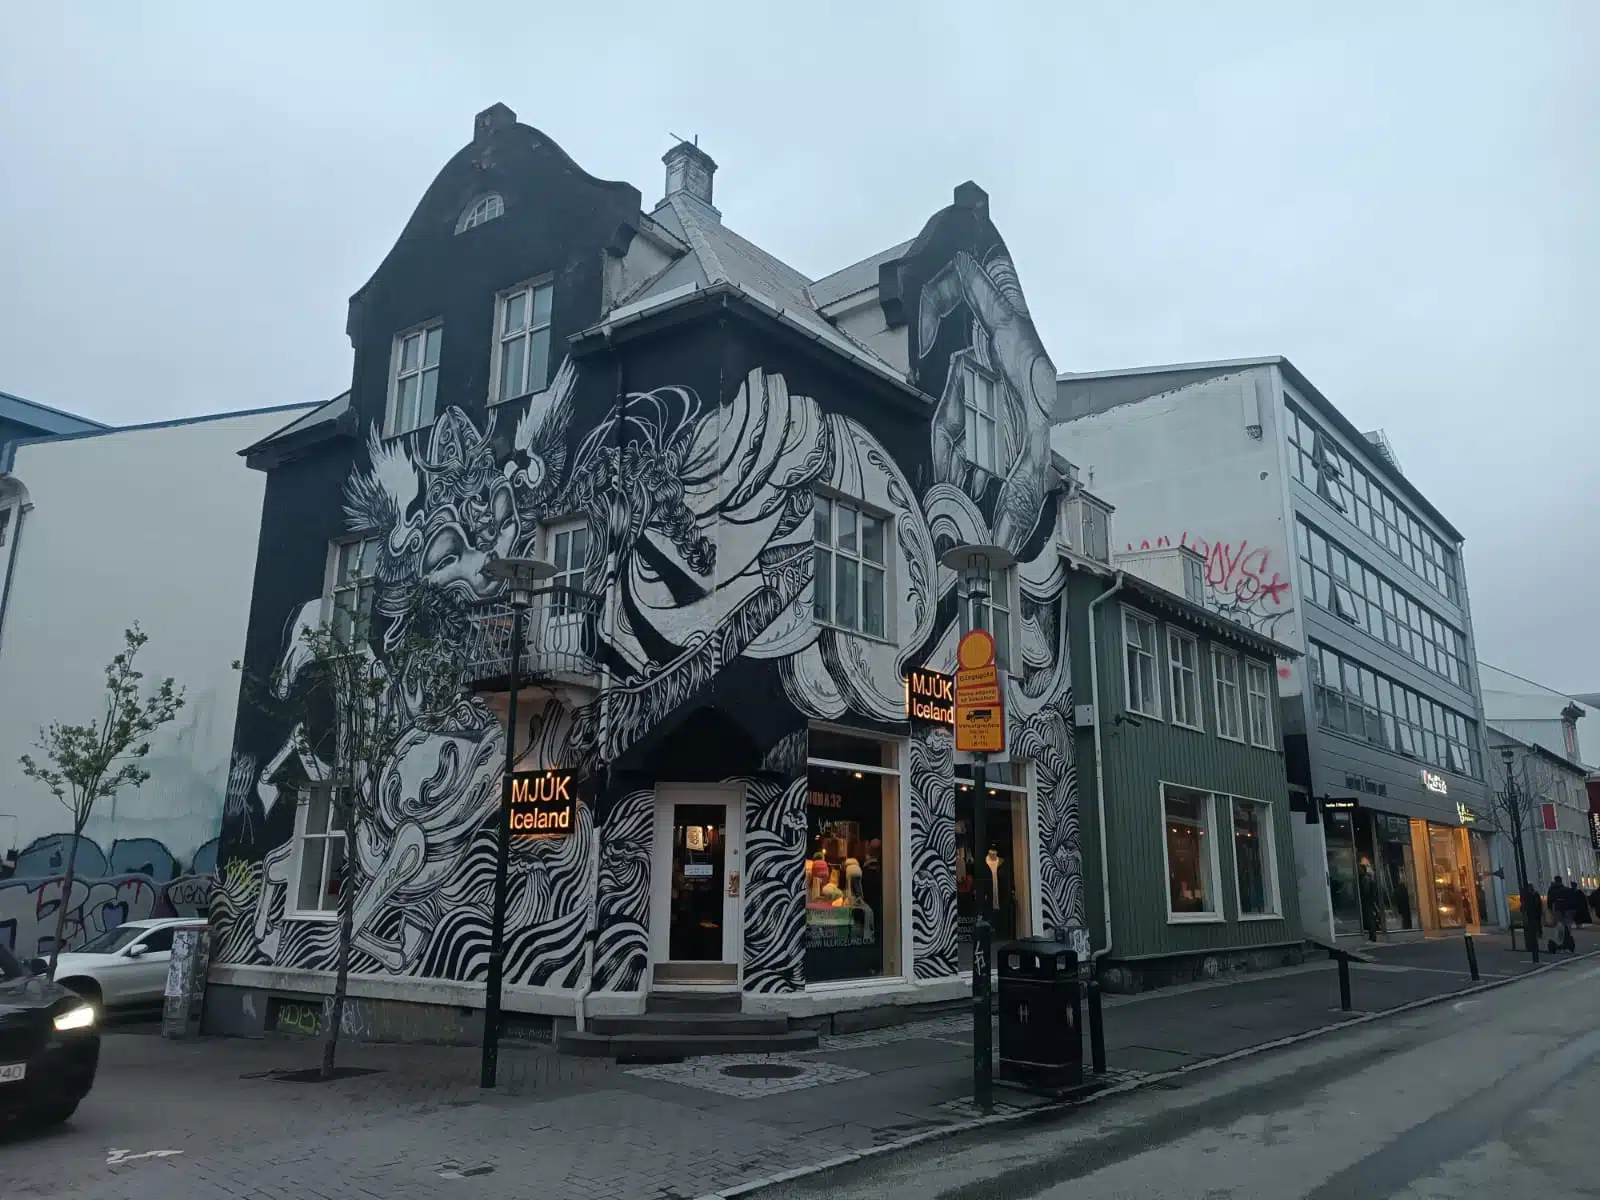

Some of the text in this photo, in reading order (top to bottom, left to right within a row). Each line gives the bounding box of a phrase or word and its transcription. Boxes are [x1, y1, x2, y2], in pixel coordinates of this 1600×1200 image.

[912, 671, 953, 702] MJÚK
[912, 697, 954, 723] Iceland
[511, 772, 571, 803] MJÚK
[509, 806, 571, 829] Iceland
[0, 1066, 21, 1079] 40
